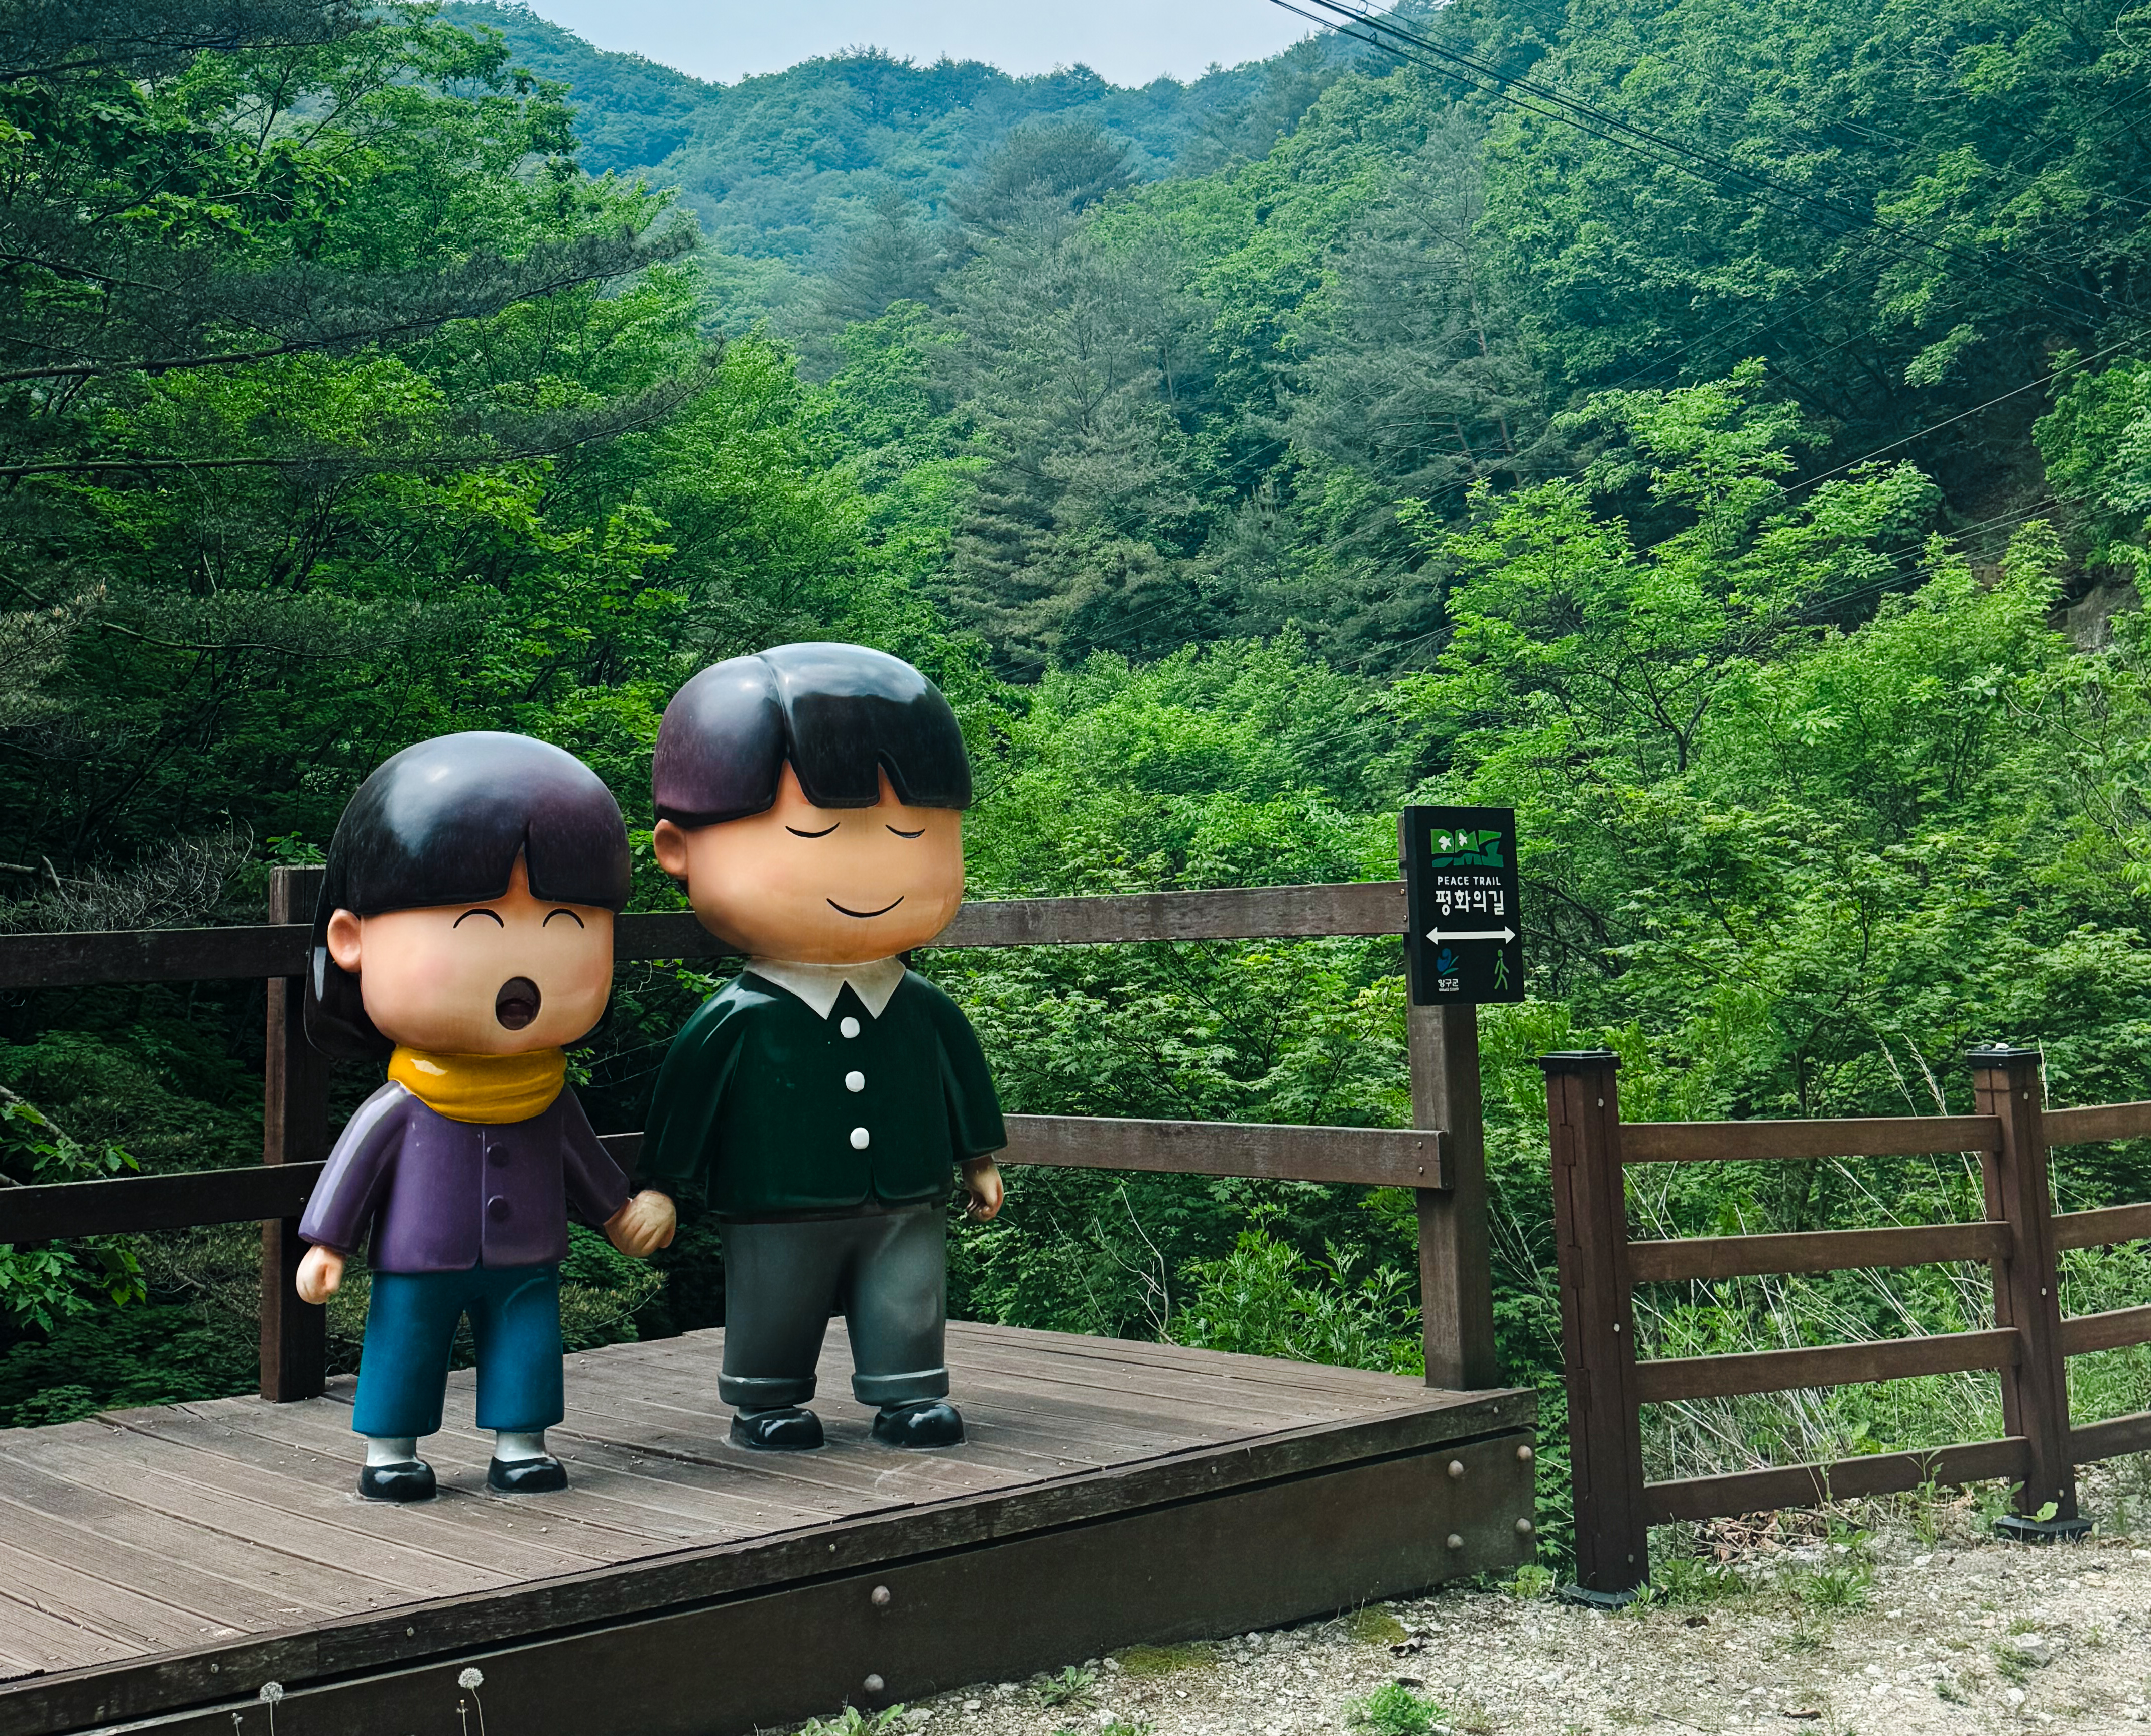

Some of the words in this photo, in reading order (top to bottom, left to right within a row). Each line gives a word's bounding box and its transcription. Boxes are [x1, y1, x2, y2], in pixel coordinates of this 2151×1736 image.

[1438, 876, 1469, 885] PEACE
[1473, 876, 1501, 885] TRAIL
[1436, 890, 1504, 916] 평화의길
[1438, 979, 1458, 988] 양구군
